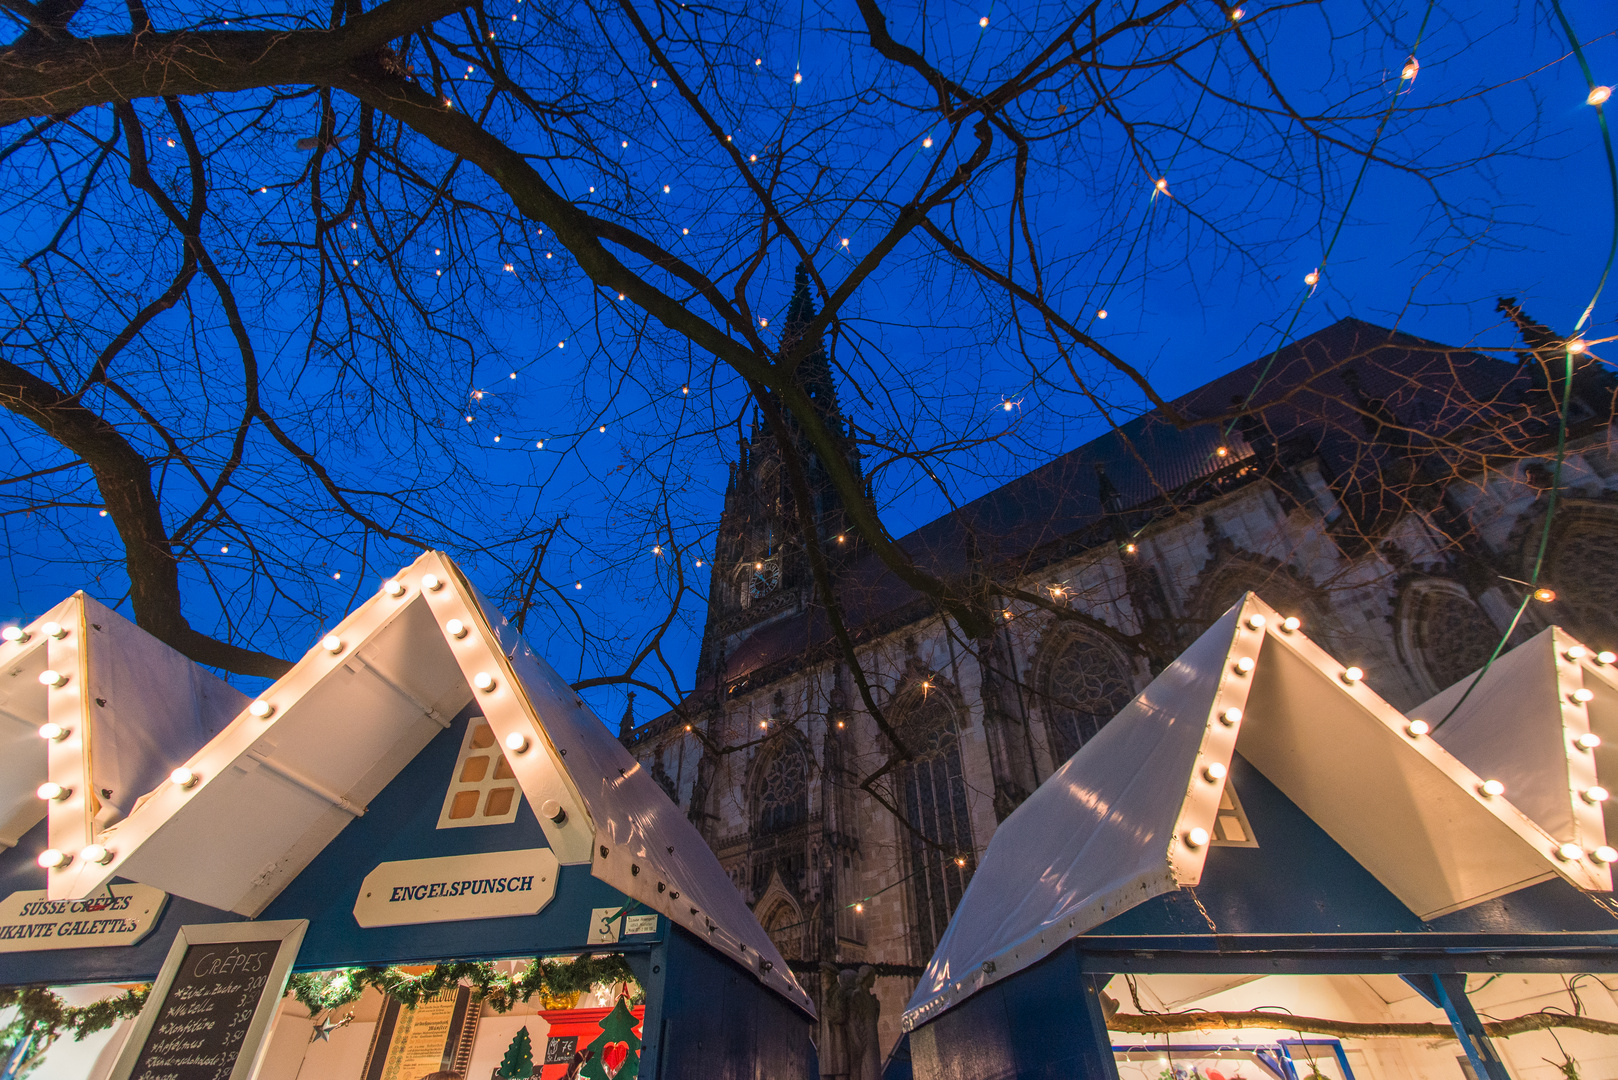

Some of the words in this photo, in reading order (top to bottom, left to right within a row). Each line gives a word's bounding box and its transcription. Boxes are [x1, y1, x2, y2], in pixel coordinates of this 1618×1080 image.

[389, 875, 534, 902] ENGELSPUNSCH
[19, 897, 66, 916] SÜSSE
[70, 893, 133, 912] CRÊPES
[0, 922, 58, 940] IKANTE
[57, 918, 138, 936] GALETTES
[599, 917, 611, 934] 3
[193, 946, 268, 978] CRÊPES
[211, 981, 241, 996] Zucker
[243, 975, 268, 992] 3,00
[173, 998, 215, 1017] Nutella
[157, 1038, 205, 1055] Apfelmus
[222, 1029, 245, 1047] 3,50
